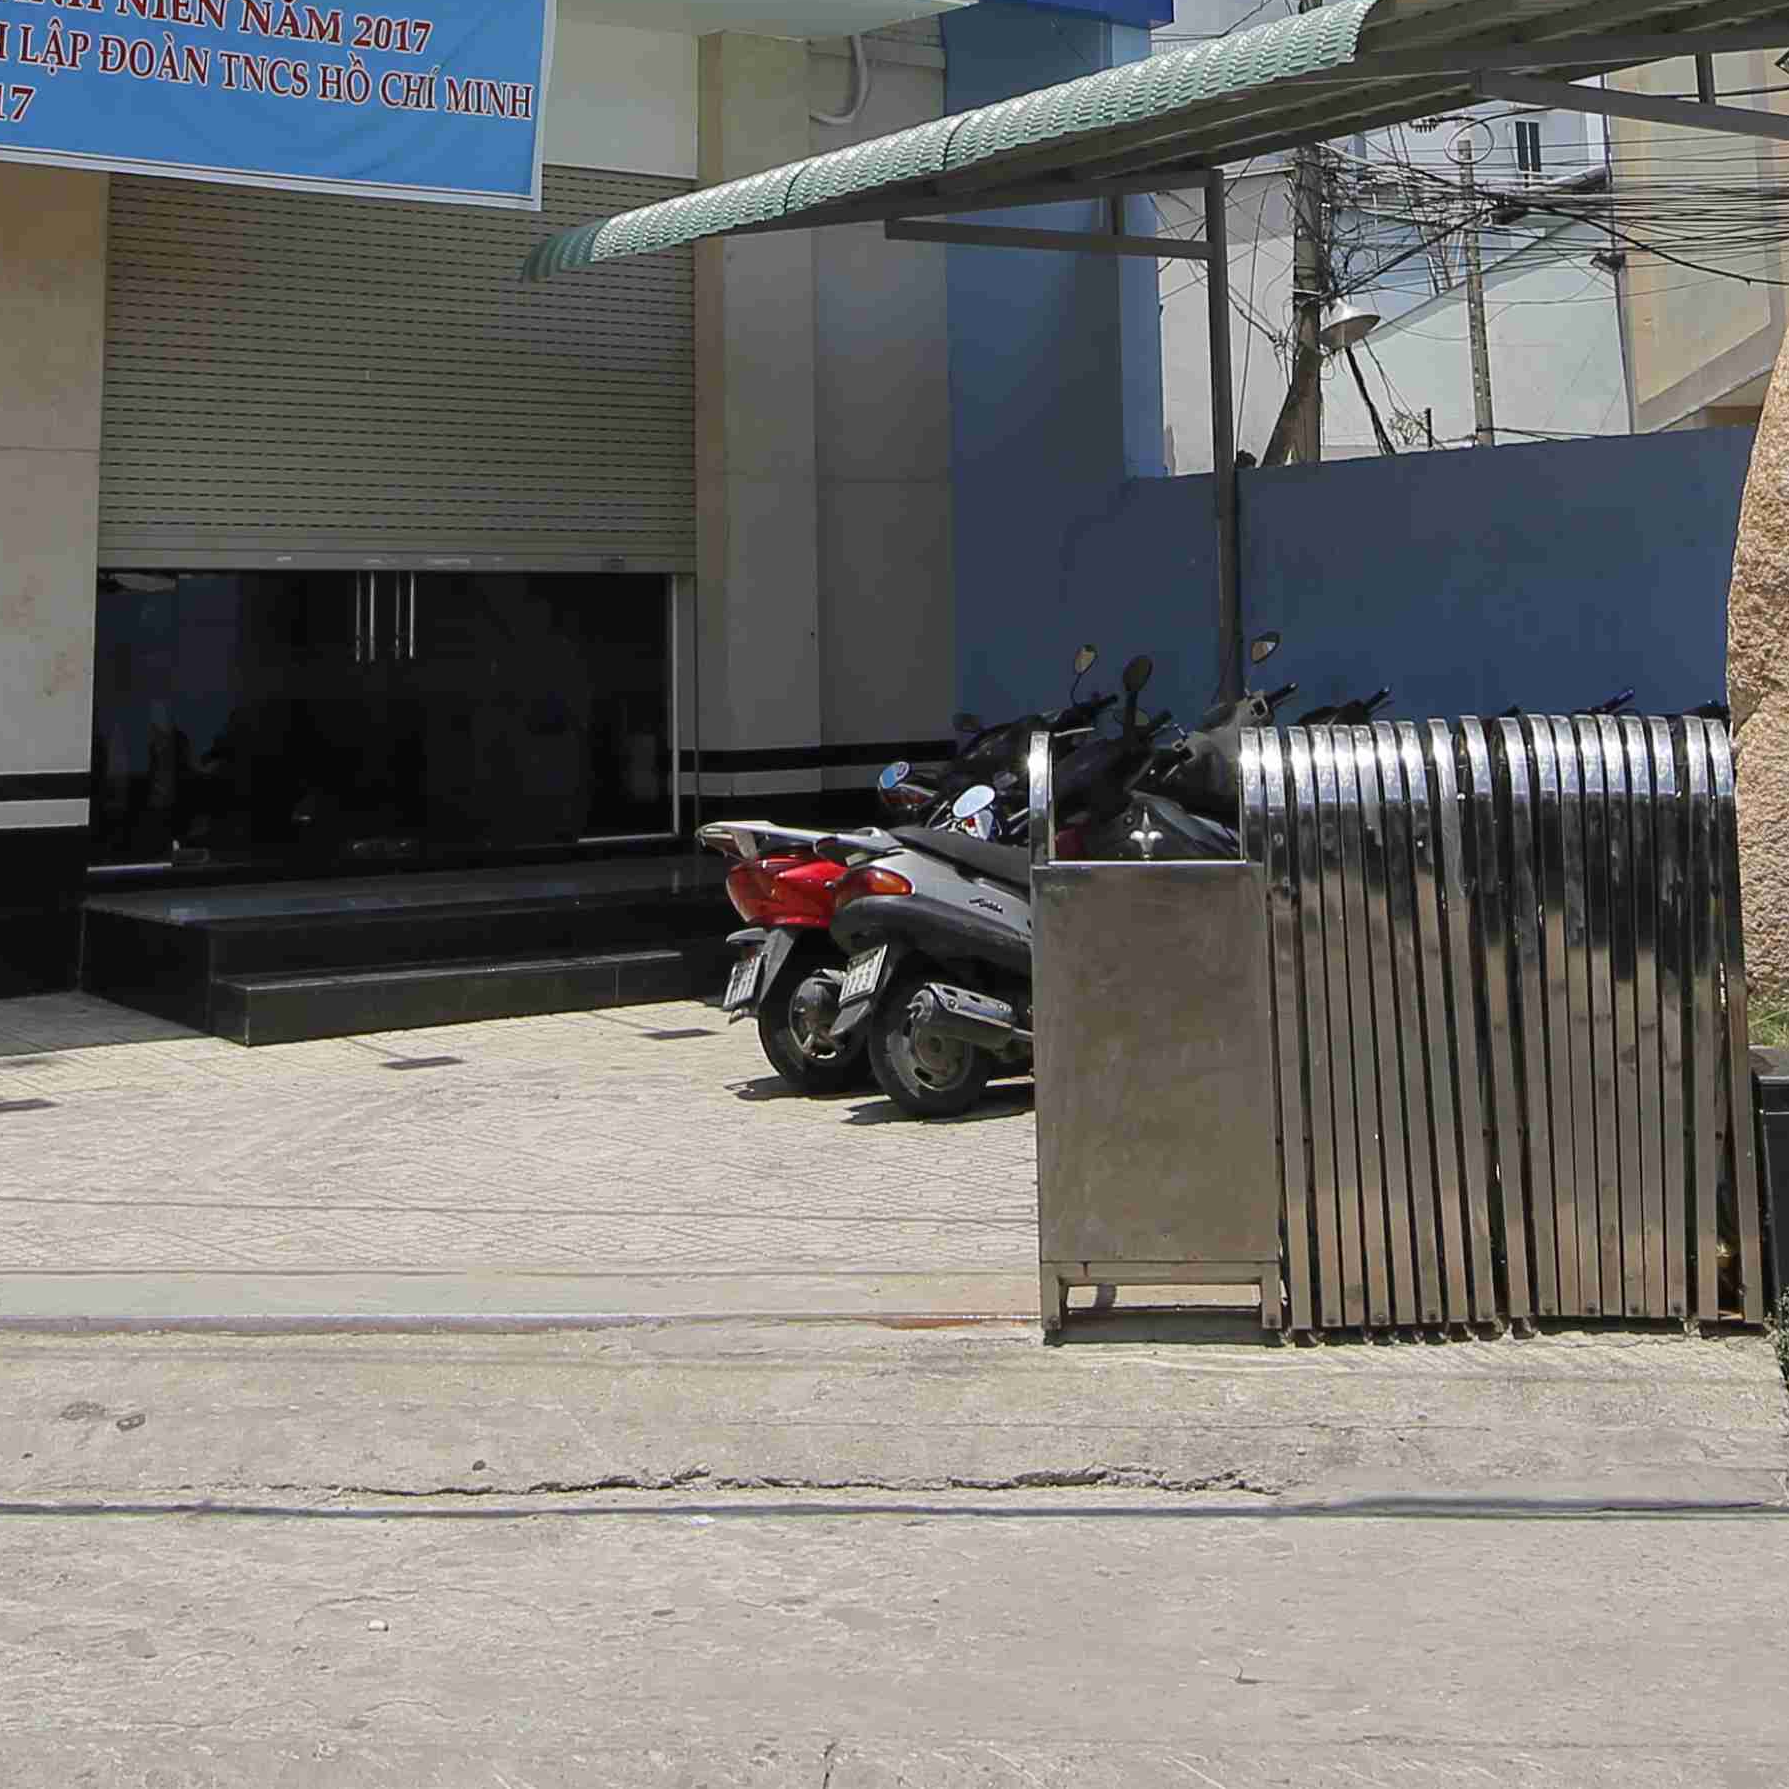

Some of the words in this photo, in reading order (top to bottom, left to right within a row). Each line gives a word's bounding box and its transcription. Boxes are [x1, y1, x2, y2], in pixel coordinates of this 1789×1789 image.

[17, 17, 90, 76] LẬP
[98, 29, 210, 88] ĐOÀN
[218, 50, 310, 99] TNCS
[316, 50, 373, 107] HỒ
[379, 65, 439, 112] CHÍ
[445, 74, 533, 120] MINH
[352, 14, 434, 56] 2017
